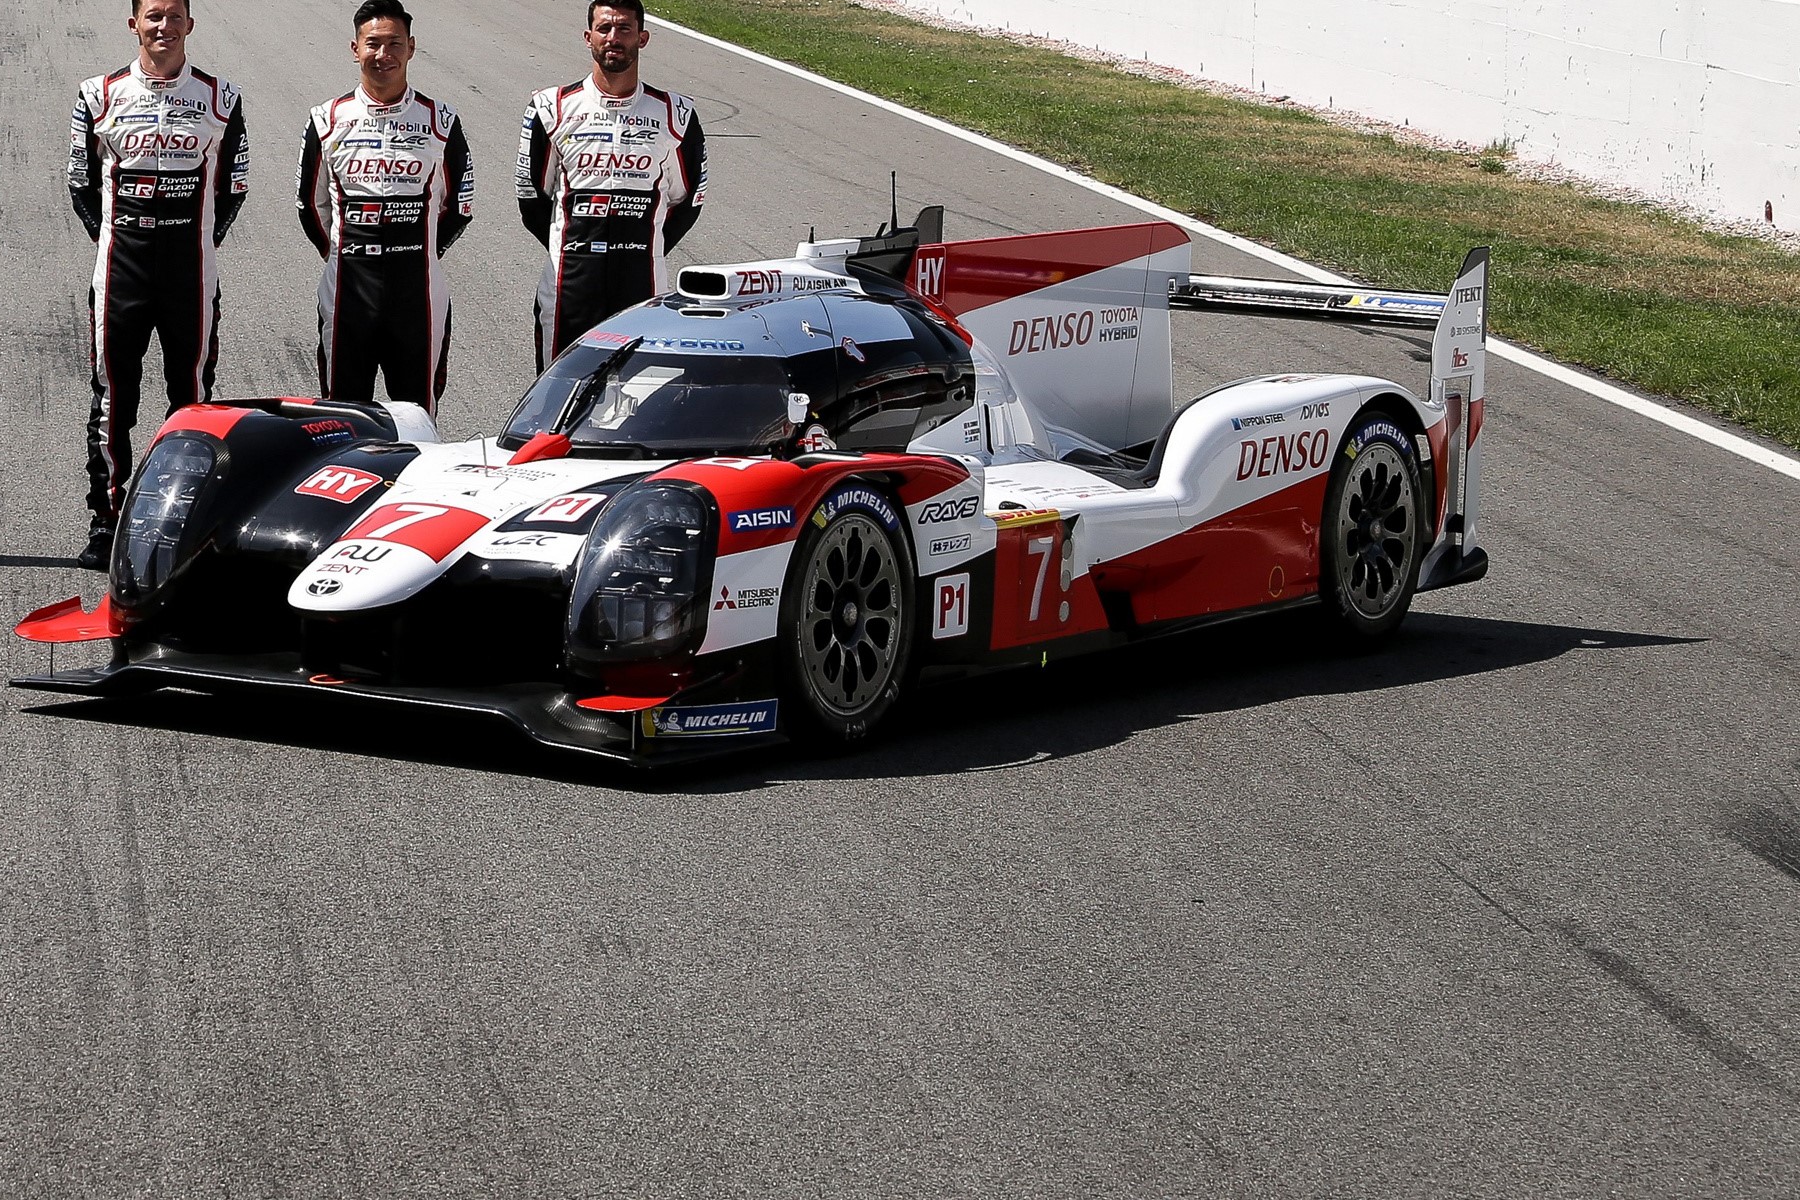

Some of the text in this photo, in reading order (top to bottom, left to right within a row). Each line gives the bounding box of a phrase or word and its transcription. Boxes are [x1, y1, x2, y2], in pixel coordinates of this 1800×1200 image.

[165, 95, 195, 107] Mobil
[166, 110, 206, 120] WEC
[619, 115, 649, 127] Mobil
[389, 121, 419, 132] Mobil
[125, 134, 199, 150] DENSO
[391, 136, 429, 145] WEC
[621, 130, 659, 140] WEC
[348, 160, 422, 175] DENSO
[577, 153, 651, 170] DENSO
[119, 185, 151, 196] GR
[613, 195, 651, 203] TOYOTA
[346, 211, 379, 223] GR
[573, 204, 607, 216] GR
[735, 270, 783, 296] ZENT
[807, 280, 833, 290] AISIN
[834, 278, 847, 288] AW
[917, 257, 943, 296] HY
[1455, 287, 1482, 307] JTEKT
[1100, 307, 1138, 324] TOYOTA
[1008, 310, 1094, 356] DENSO
[1099, 326, 1138, 342] HYBRID
[1462, 327, 1480, 335] SYSTEMS
[643, 337, 744, 351] HYBRID
[301, 420, 344, 435] TOYOTA
[1241, 413, 1285, 428] NIPPON STEEL
[1364, 422, 1408, 449] MICHELIN
[1236, 428, 1329, 481] DENSO
[305, 469, 373, 495] HY
[538, 498, 593, 515] P1
[837, 490, 894, 524] MICHELIN
[918, 496, 979, 525] RAYS
[366, 504, 450, 538] 7
[736, 511, 790, 529] AISIN
[491, 534, 558, 546] WEC
[317, 564, 369, 575] ZENT
[1028, 536, 1053, 622] 7
[738, 587, 779, 599] MITSUBISHI
[738, 597, 774, 608] ELECTRIC
[939, 582, 965, 630] P1
[685, 711, 766, 727] MICHELIN
